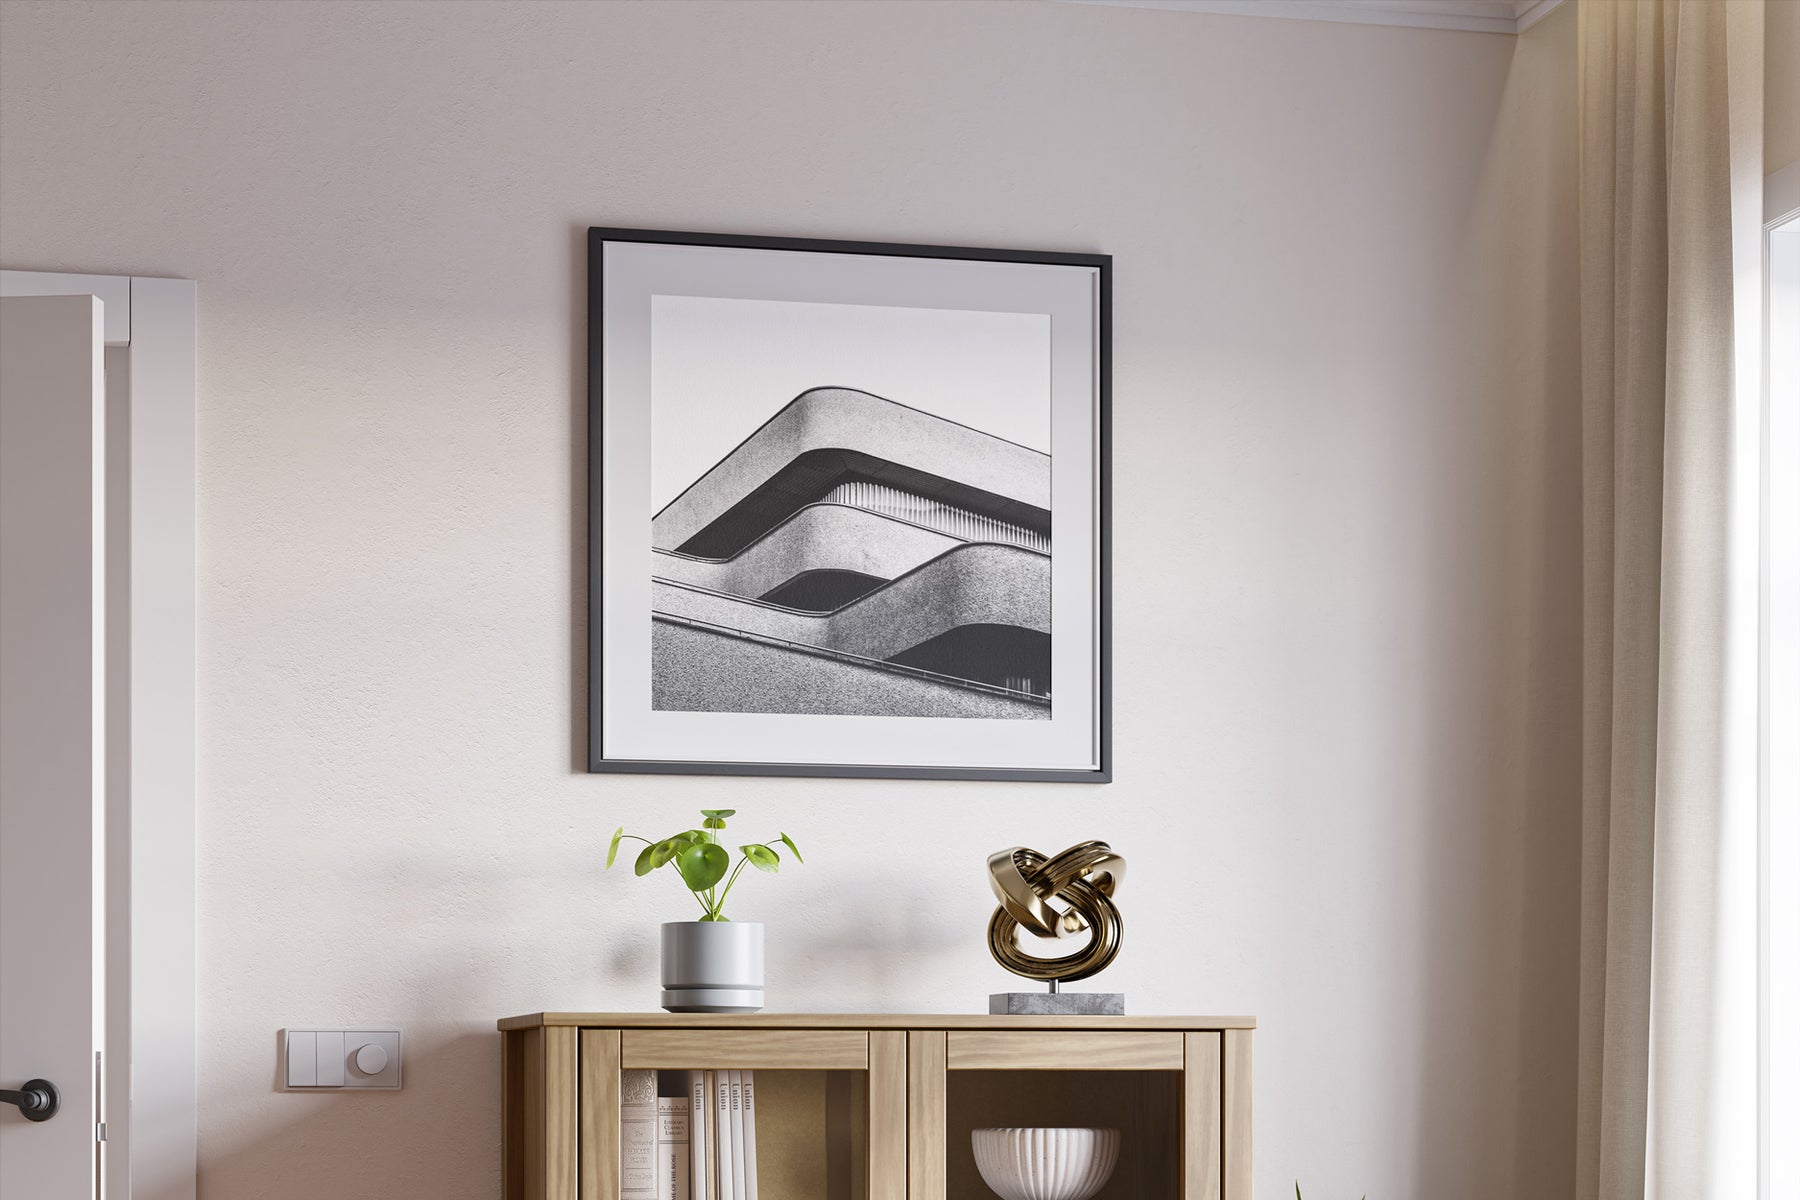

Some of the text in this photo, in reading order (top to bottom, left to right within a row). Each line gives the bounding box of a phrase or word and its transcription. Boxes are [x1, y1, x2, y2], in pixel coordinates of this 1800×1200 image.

[719, 1083, 728, 1110] Union
[732, 1083, 740, 1110] Union
[744, 1083, 752, 1110] Union
